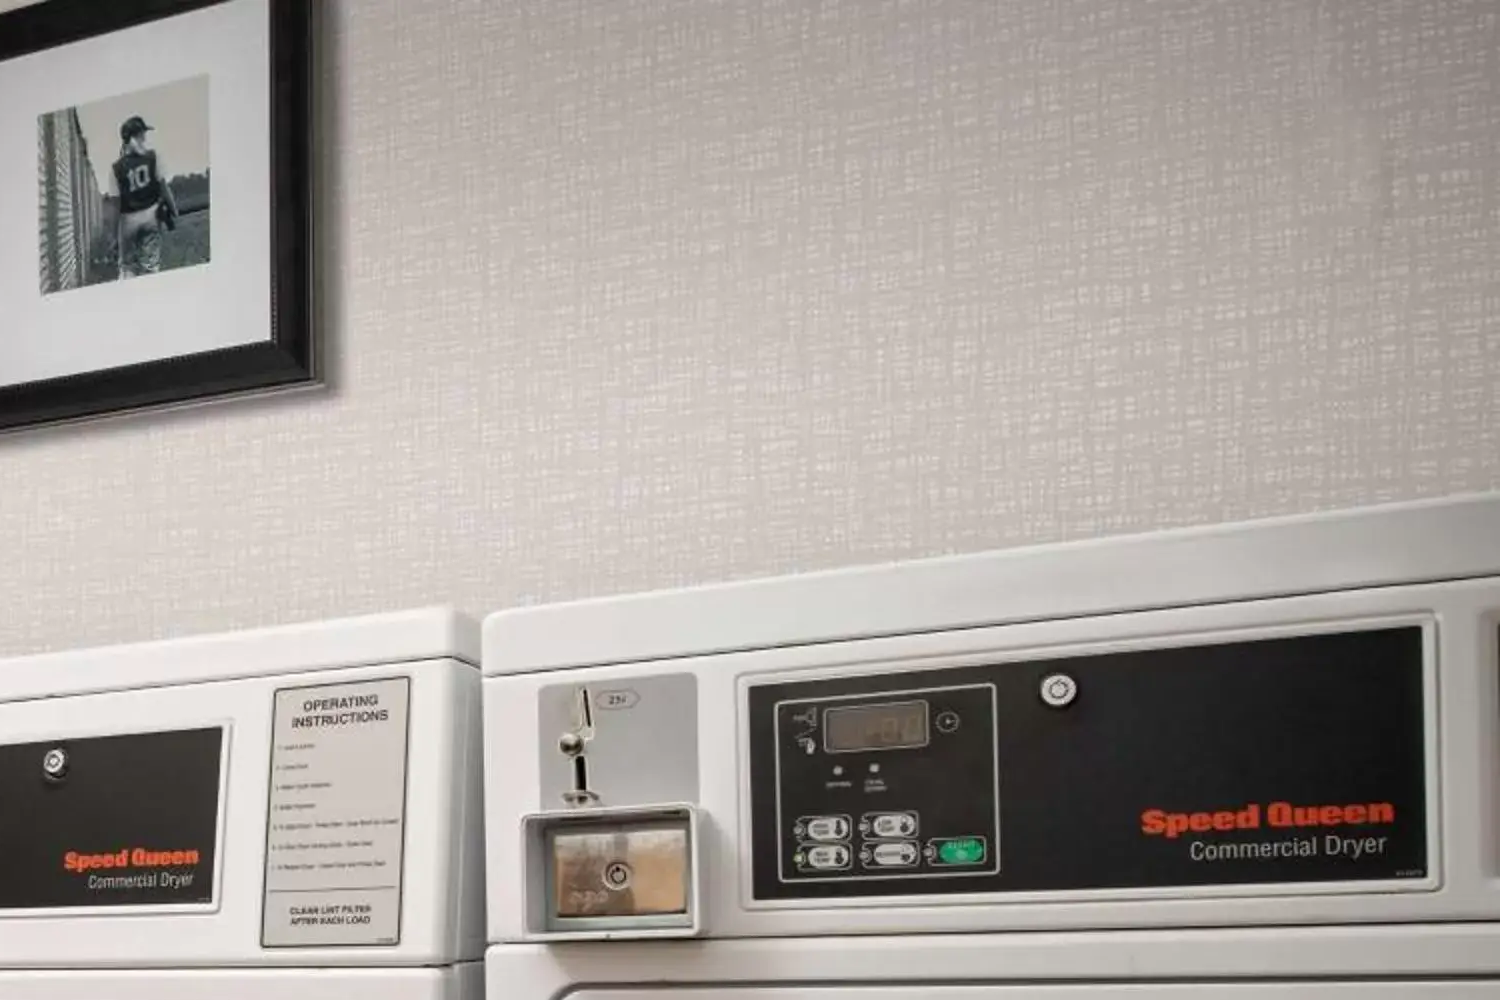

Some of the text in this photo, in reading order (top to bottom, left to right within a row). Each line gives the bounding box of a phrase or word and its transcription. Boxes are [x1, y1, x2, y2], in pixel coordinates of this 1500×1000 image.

[127, 164, 150, 192] 10
[303, 694, 379, 712] OPERATING
[291, 709, 389, 729] INSTRUCTIONS
[1141, 801, 1395, 838] Speed Queen
[1190, 834, 1388, 861] Commercial Dryer
[64, 848, 199, 872] Speed Queen
[88, 871, 194, 889] Commercial Dryer
[321, 905, 340, 914] LINT
[342, 905, 372, 914] FILTER
[290, 915, 371, 925] AFTER EACH LOAD
